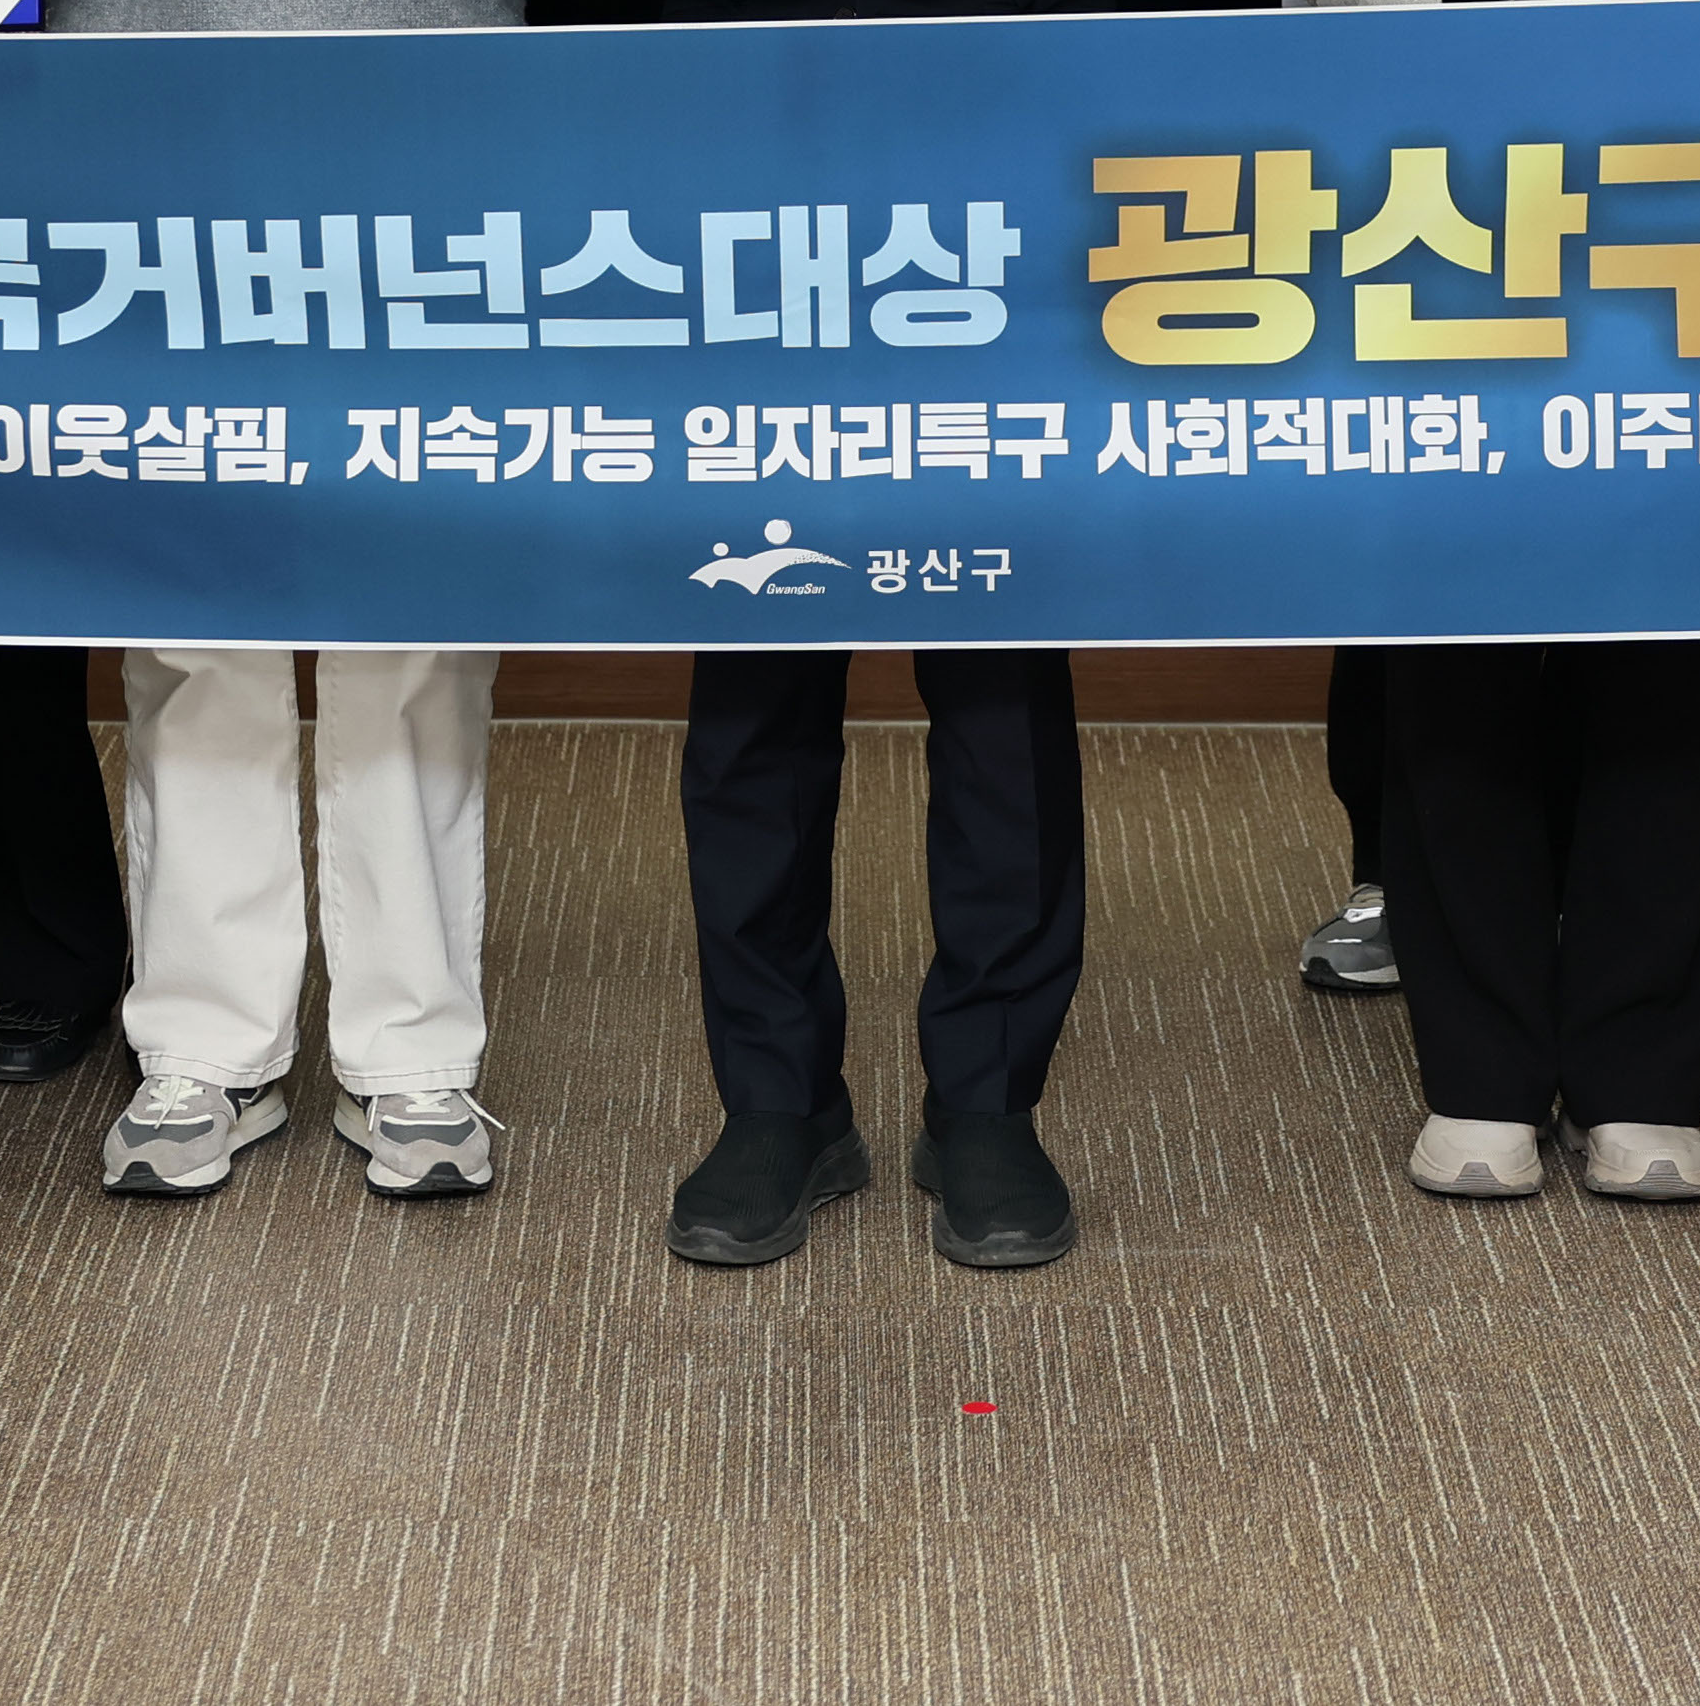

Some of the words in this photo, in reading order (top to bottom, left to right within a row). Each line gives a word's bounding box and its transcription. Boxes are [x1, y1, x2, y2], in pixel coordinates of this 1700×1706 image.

[345, 404, 656, 484] 지속가능
[683, 401, 1070, 483] 일자리특구
[1096, 393, 1507, 478] 사회적대화,
[766, 582, 826, 595] GwangSan
[865, 547, 1013, 595] 광산구
